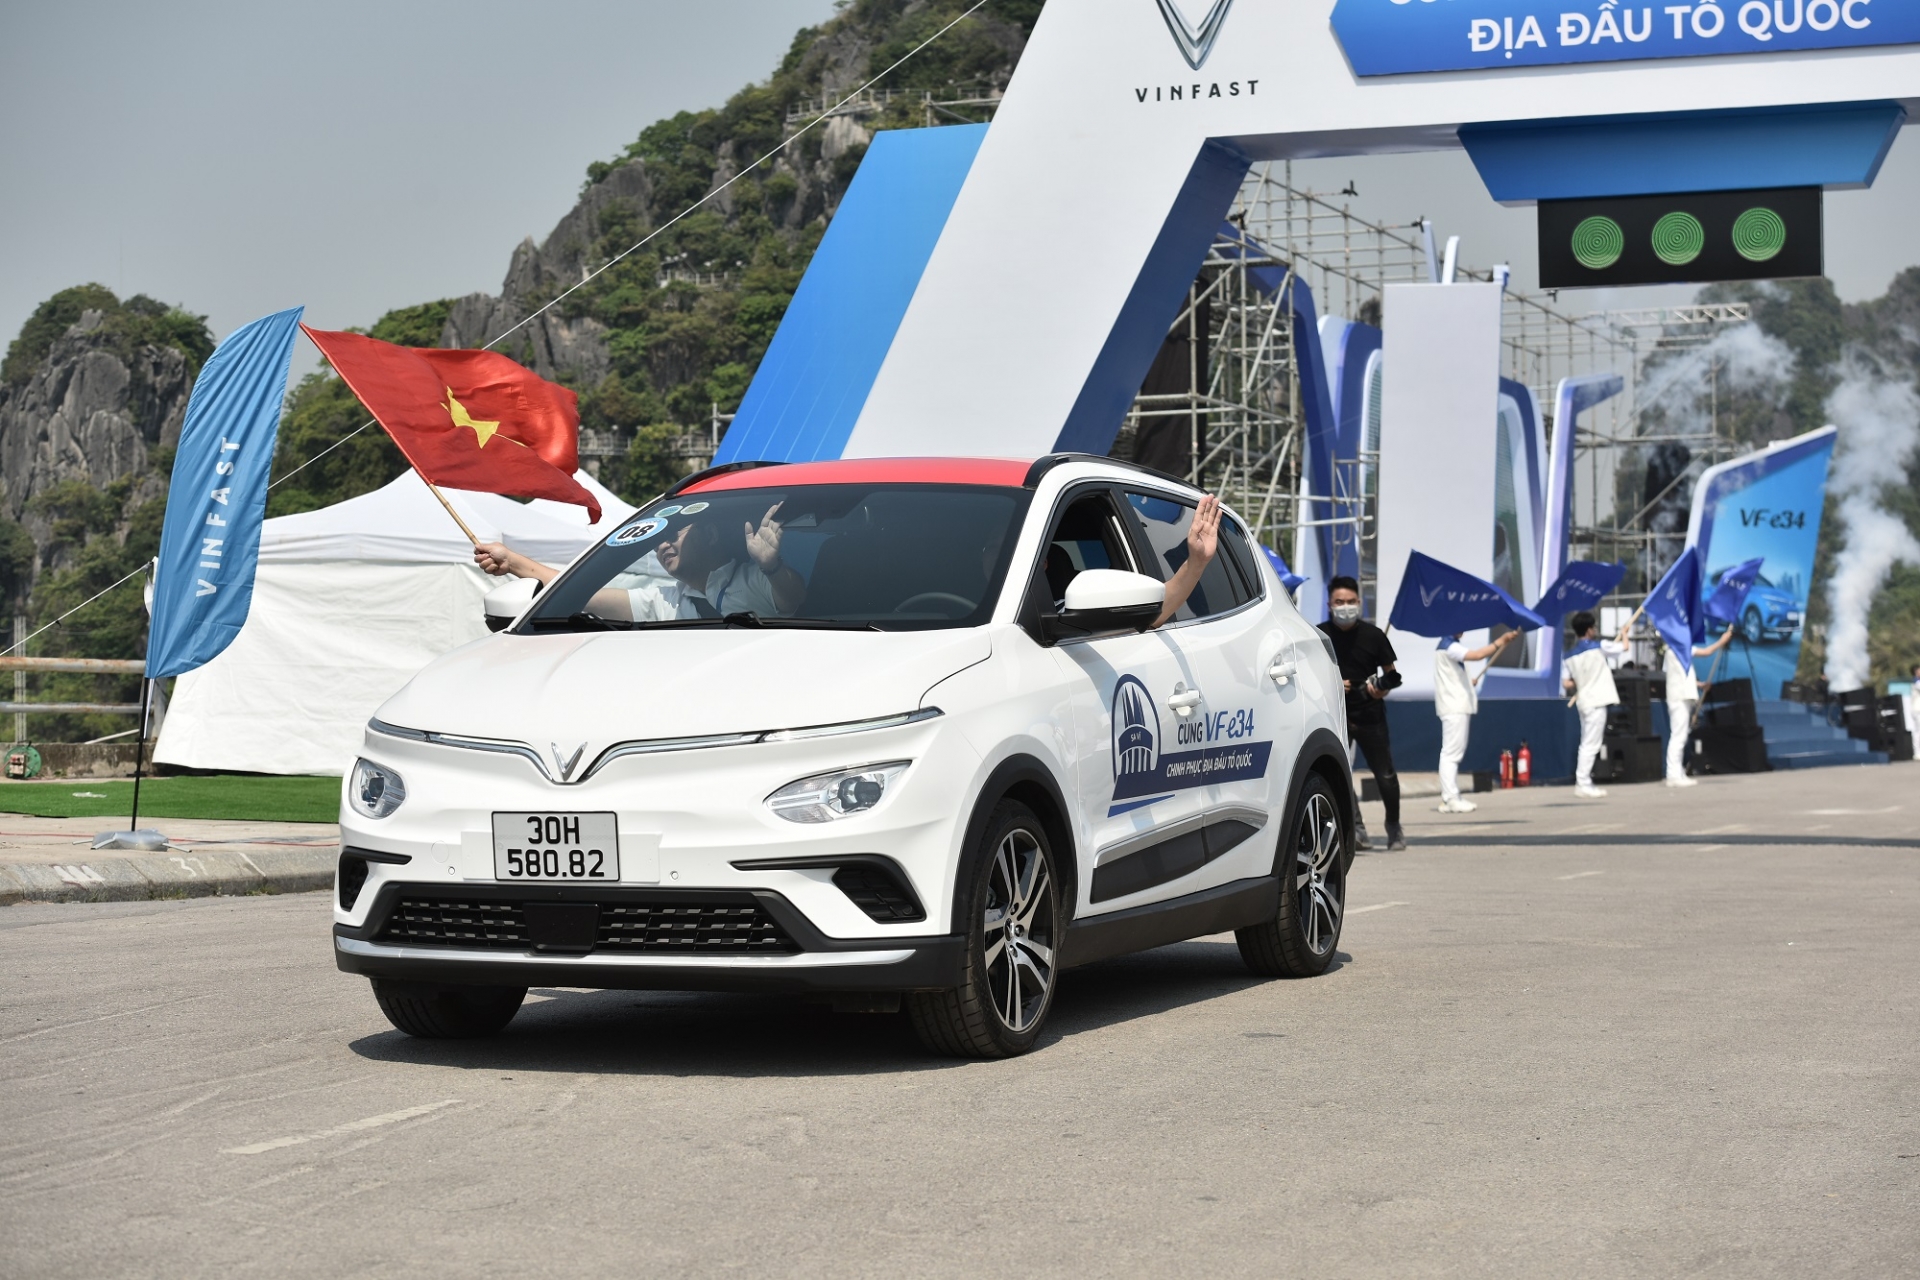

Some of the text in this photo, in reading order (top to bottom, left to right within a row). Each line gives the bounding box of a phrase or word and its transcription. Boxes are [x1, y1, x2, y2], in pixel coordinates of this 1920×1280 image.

[1467, 15, 1548, 60] ĐỊA
[1556, 0, 1652, 46] ĐẦU
[1135, 79, 1259, 103] VINFAST
[195, 436, 241, 597] VINFAST
[616, 524, 656, 540] 08
[1177, 717, 1203, 745] CÙNG
[1185, 759, 1203, 778] PHỤC
[526, 815, 581, 845] 30H
[507, 848, 605, 877] 580.82
